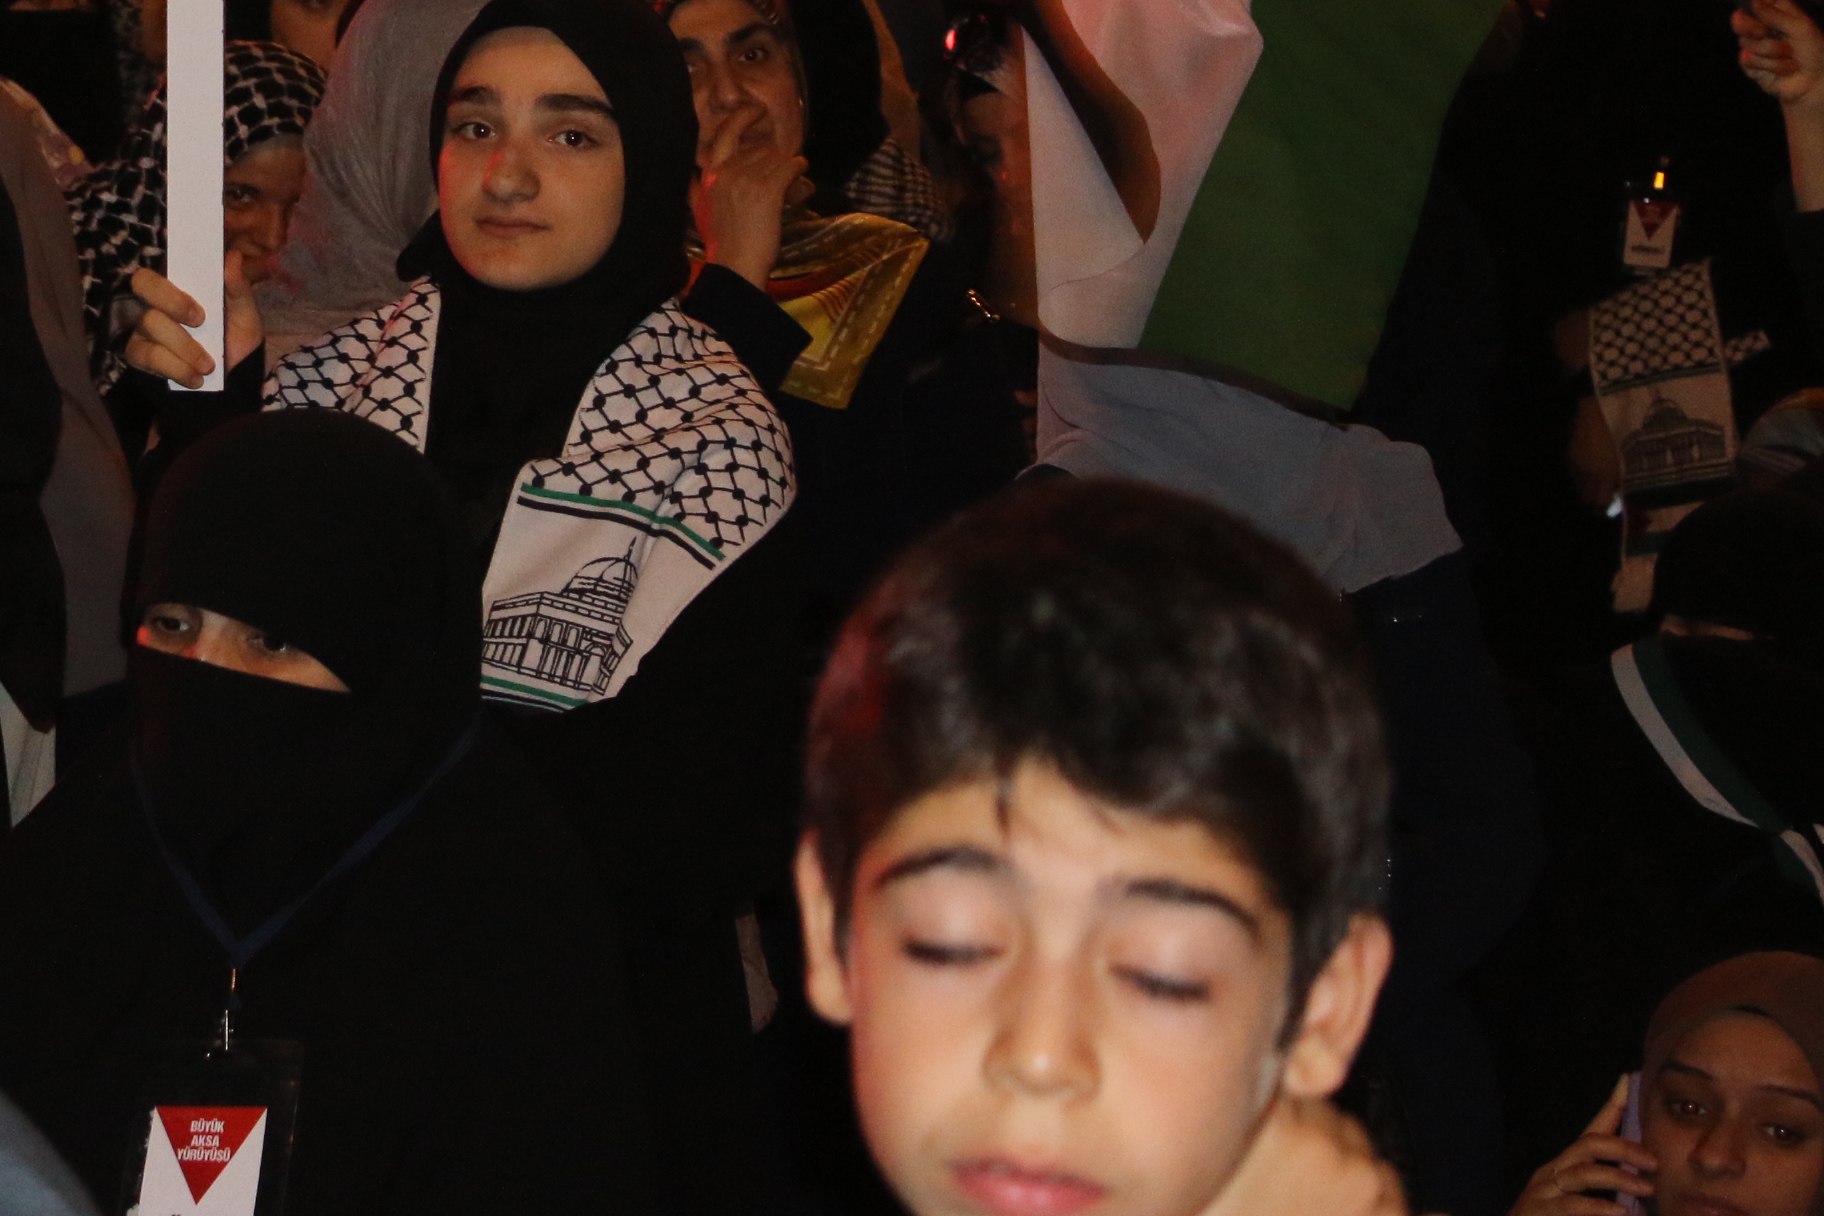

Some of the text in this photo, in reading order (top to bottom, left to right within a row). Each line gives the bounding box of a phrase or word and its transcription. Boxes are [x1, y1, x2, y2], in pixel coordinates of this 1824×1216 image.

[190, 1117, 225, 1133] BÜYÜK
[191, 1134, 220, 1147] AKSA
[177, 1145, 231, 1163] YÜRÜYÜŞÜ
